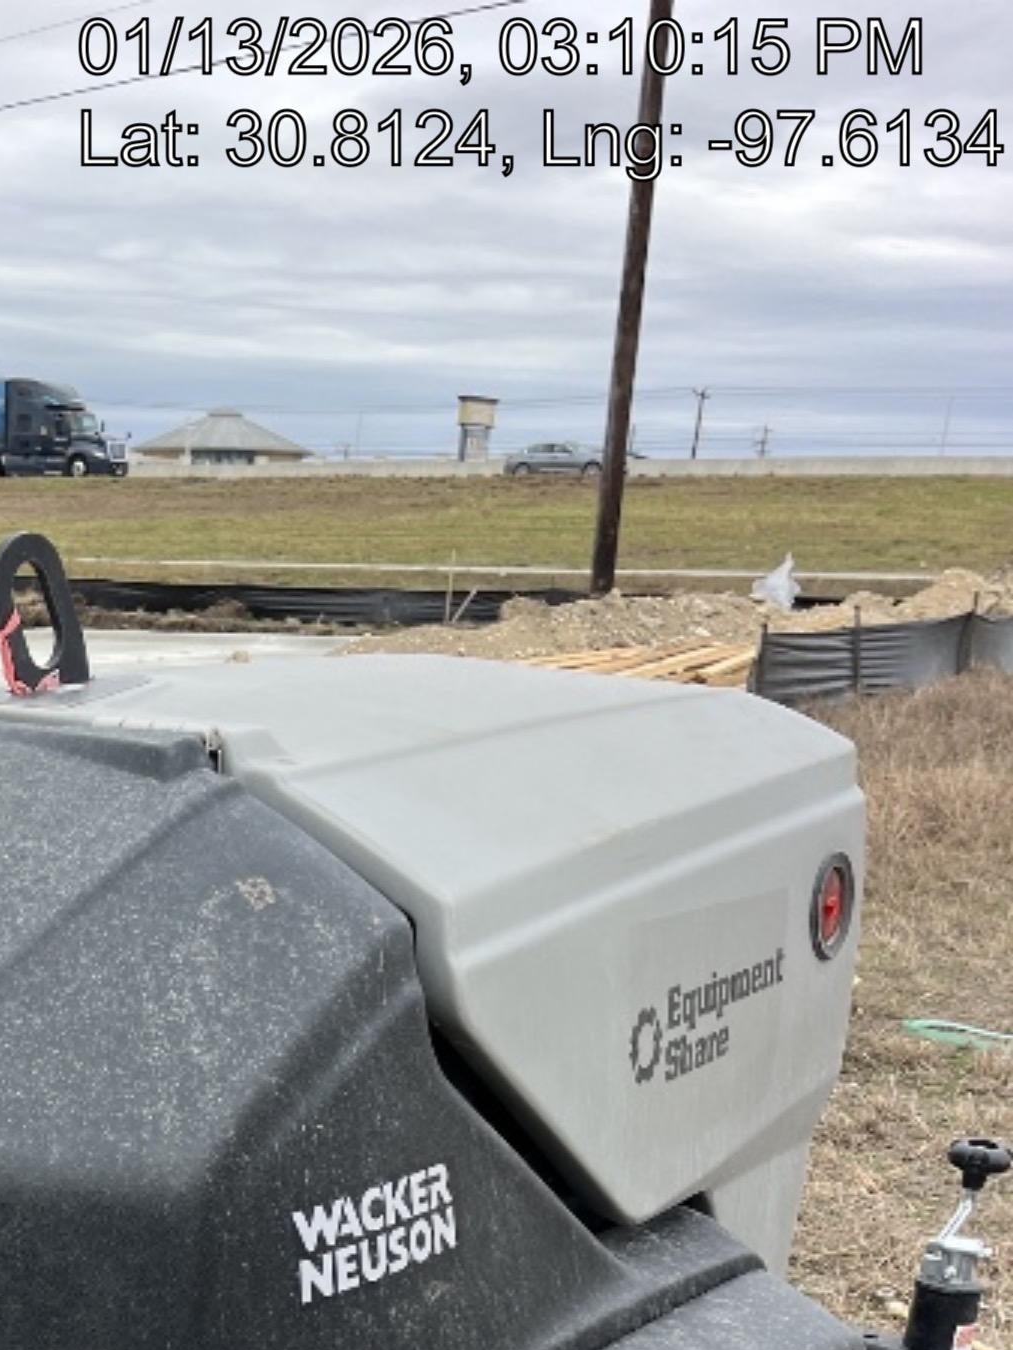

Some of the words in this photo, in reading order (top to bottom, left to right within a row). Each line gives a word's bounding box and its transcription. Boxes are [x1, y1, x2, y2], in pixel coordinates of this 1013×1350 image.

[667, 948, 786, 1030] Equipment
[665, 1025, 730, 1083] Share
[292, 1162, 453, 1252] WACKER
[299, 1205, 457, 1305] NEUSON
